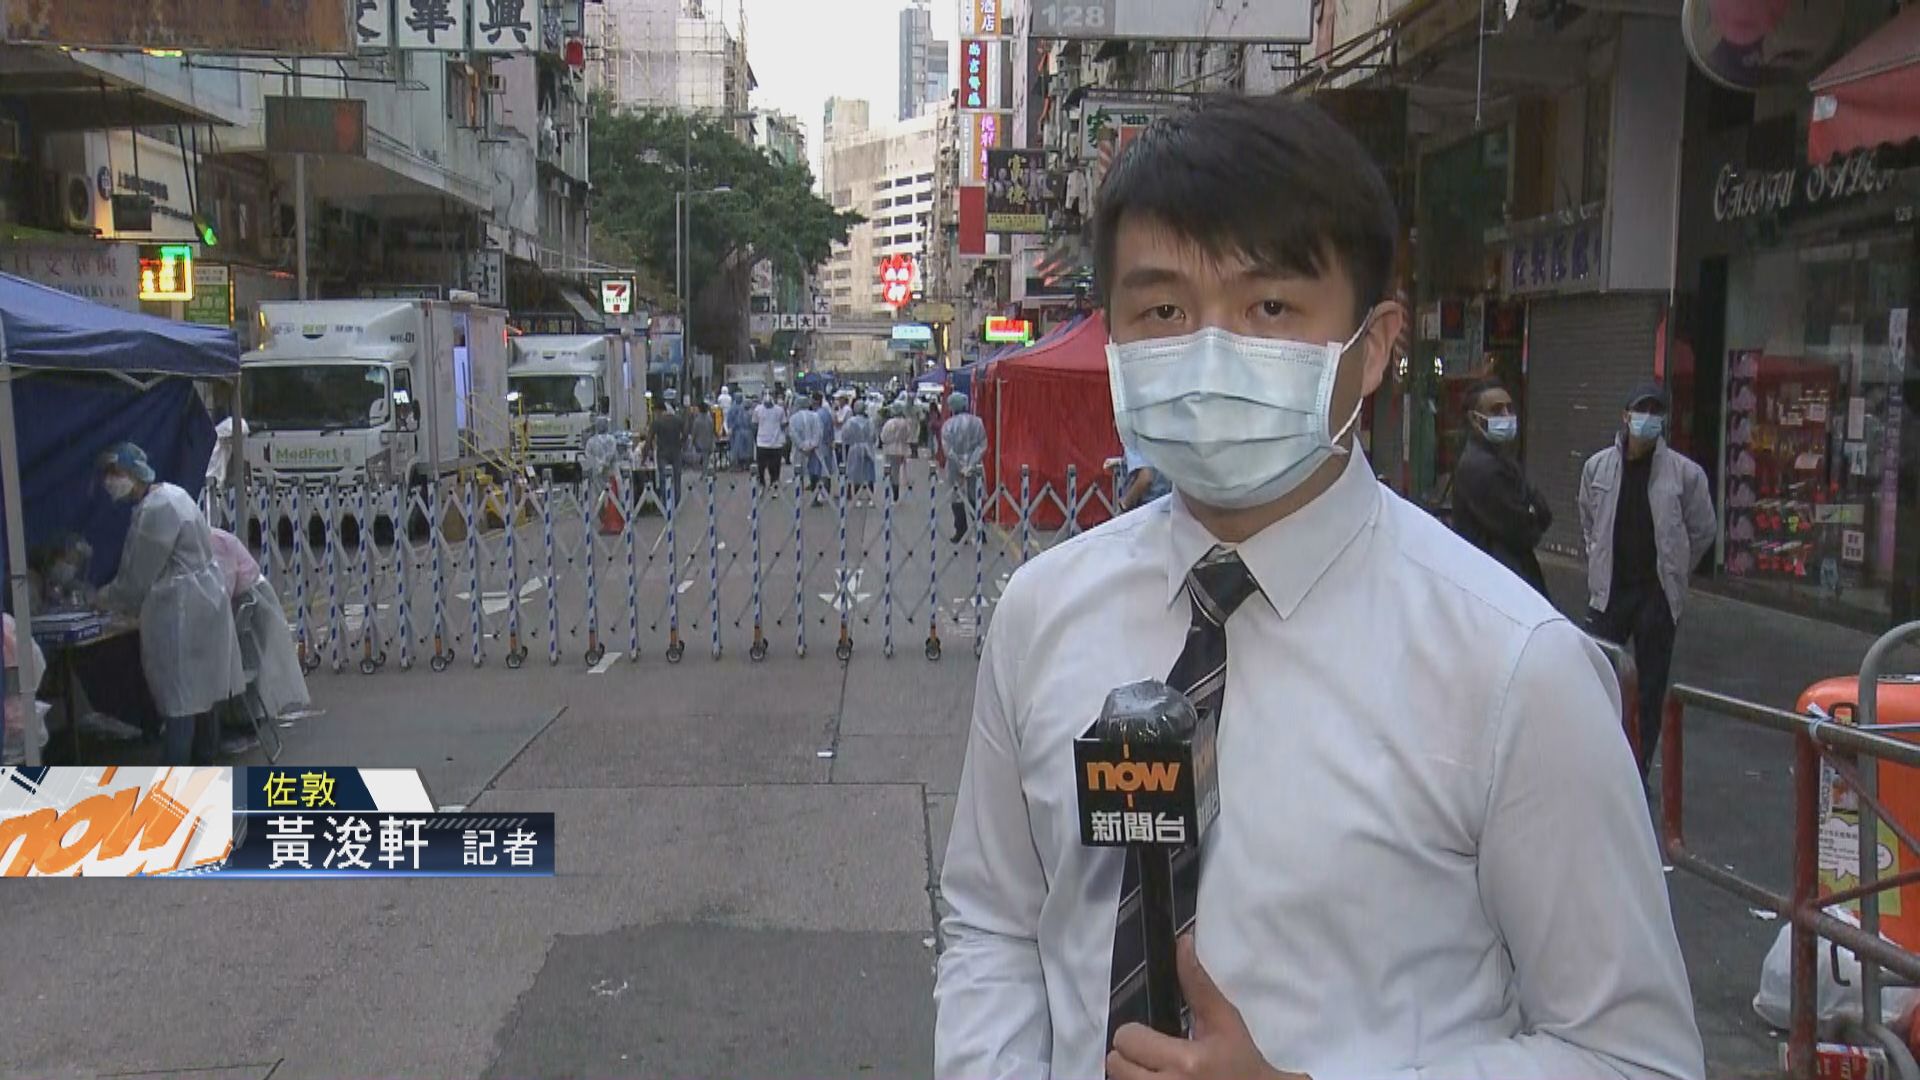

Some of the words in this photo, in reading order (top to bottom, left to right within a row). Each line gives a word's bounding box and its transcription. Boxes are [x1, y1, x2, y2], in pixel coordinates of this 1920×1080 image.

[1042, 6, 1105, 27] 128
[1087, 761, 1180, 791] now
[1091, 811, 1185, 842] 新聞台
